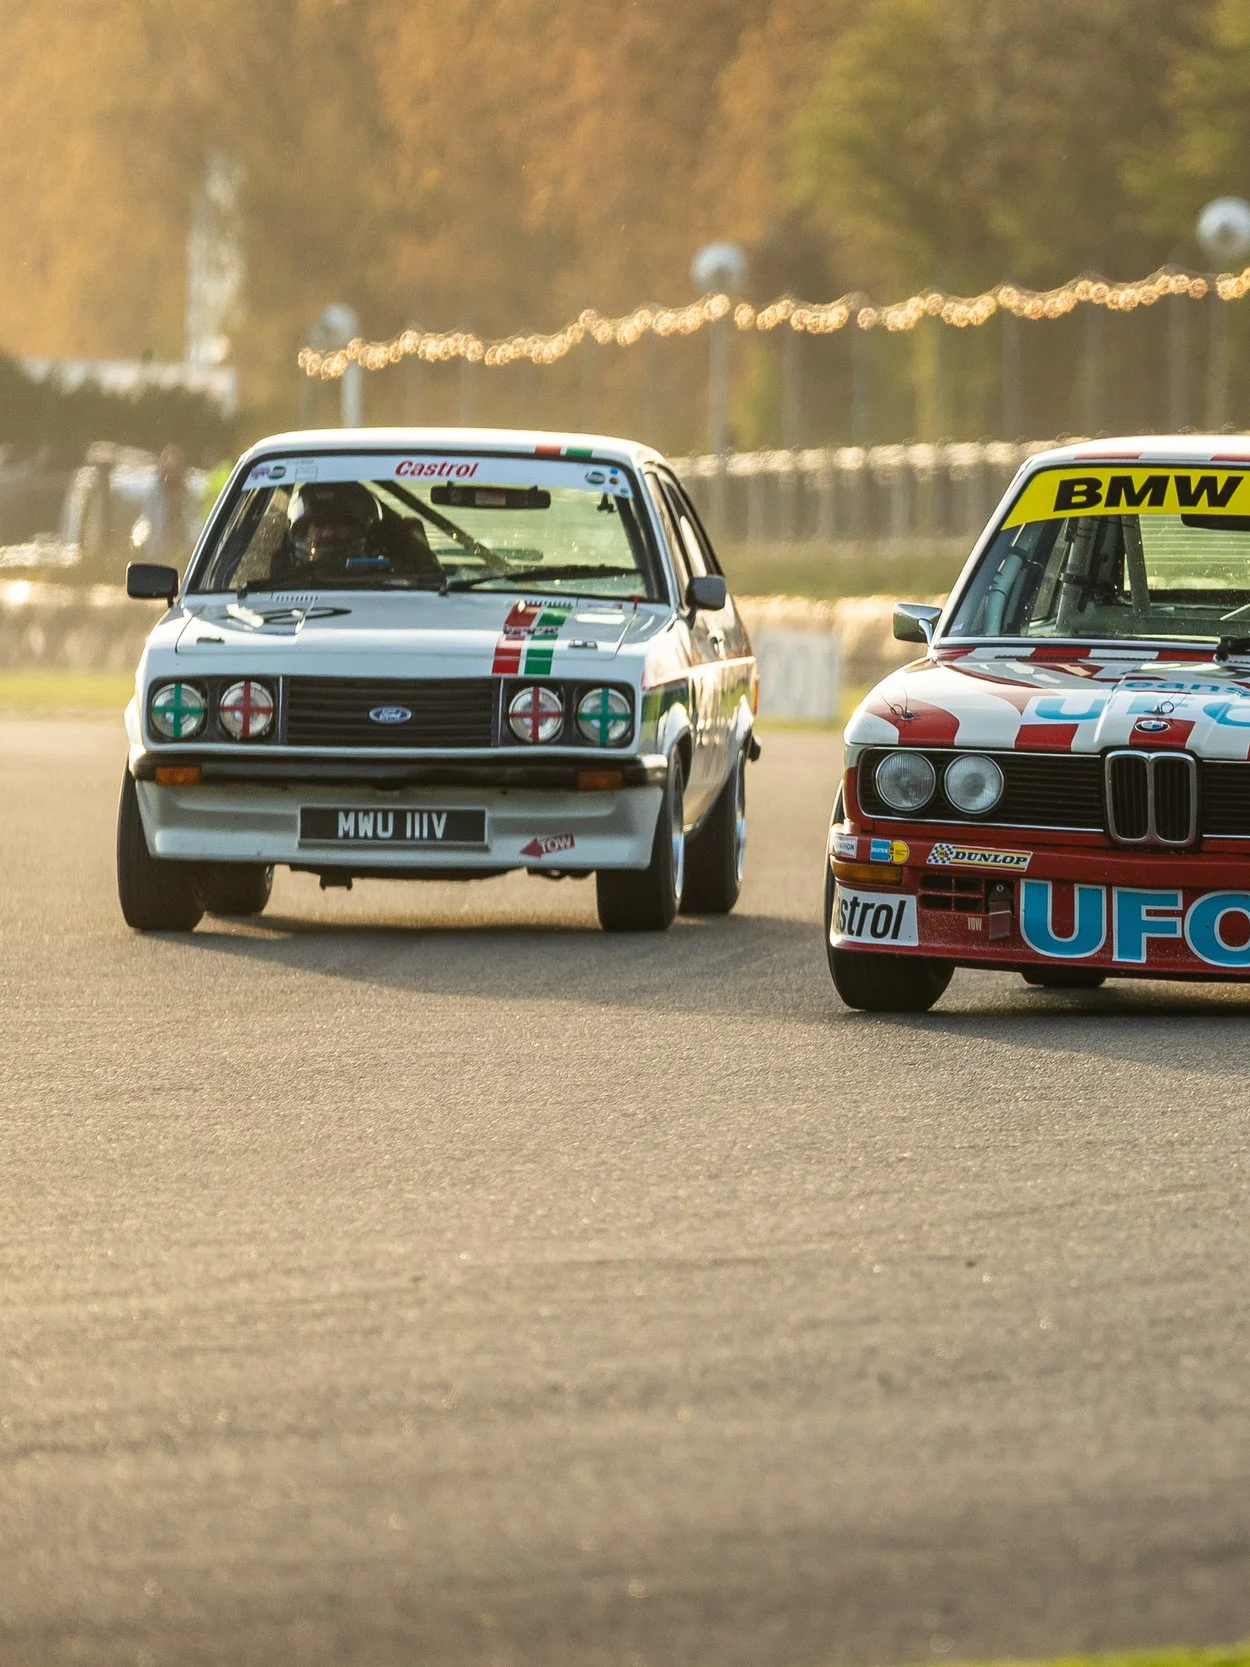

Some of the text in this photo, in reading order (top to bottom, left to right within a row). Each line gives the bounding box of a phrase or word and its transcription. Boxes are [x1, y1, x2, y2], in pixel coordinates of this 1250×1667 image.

[395, 460, 479, 478] Castrol
[1053, 475, 1245, 512] BMW
[337, 811, 394, 839] MWU
[540, 834, 573, 853] TOW
[952, 850, 1029, 866] DUNLOP
[838, 896, 907, 940] strol
[967, 917, 983, 931] TOW
